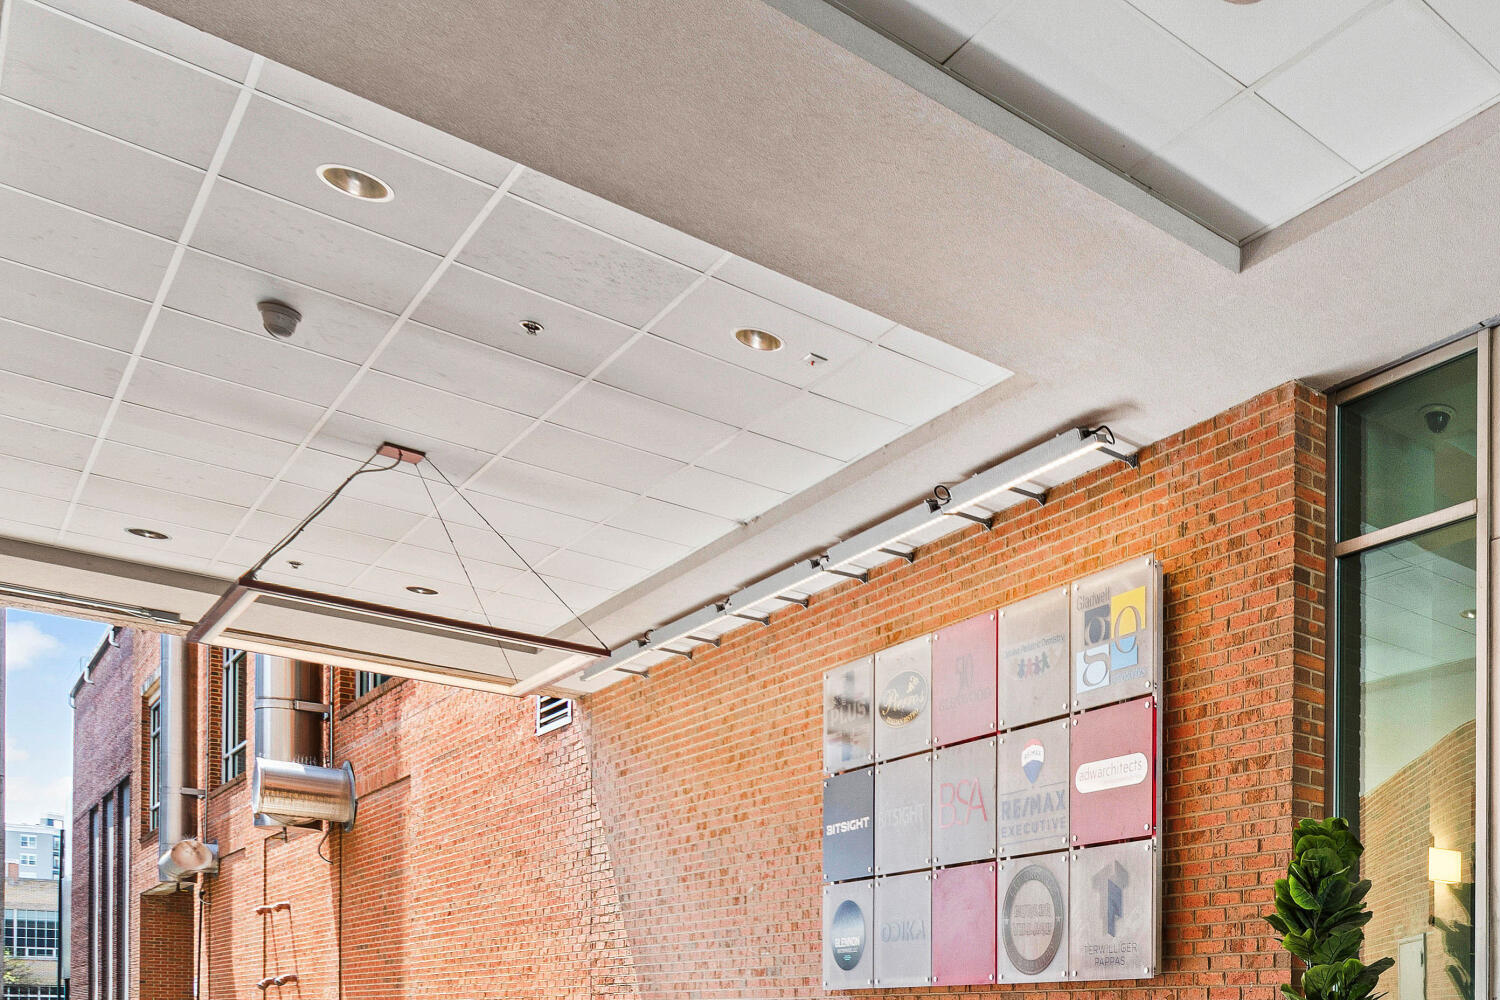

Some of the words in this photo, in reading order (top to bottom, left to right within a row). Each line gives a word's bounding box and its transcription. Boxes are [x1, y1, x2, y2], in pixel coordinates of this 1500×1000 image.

[1077, 586, 1110, 611] Gladwell
[1078, 758, 1143, 783] adwarchitects
[825, 816, 870, 837] BITSIGHT
[1001, 816, 1067, 839] EXECUTIVE
[1094, 955, 1126, 968] PAPPAS
